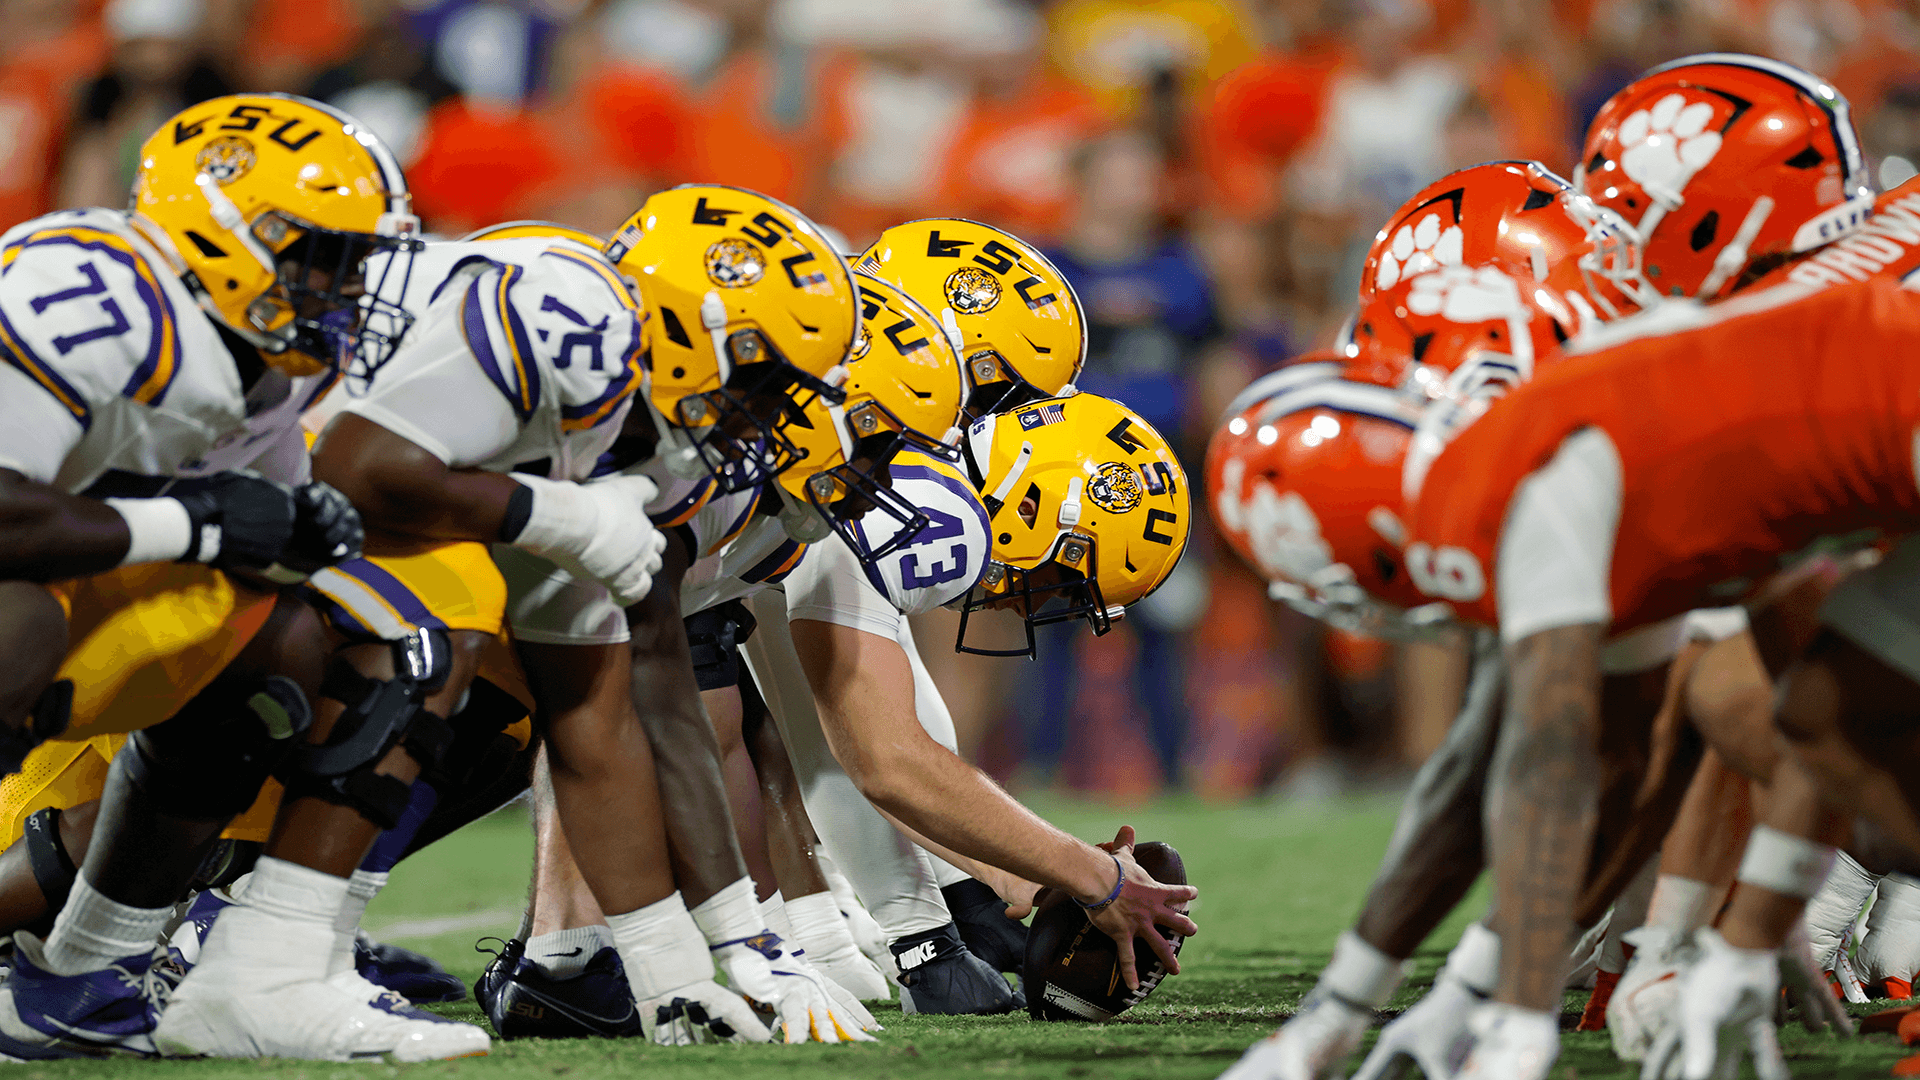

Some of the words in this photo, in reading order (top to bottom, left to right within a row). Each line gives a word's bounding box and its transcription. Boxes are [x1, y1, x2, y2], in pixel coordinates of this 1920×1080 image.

[174, 105, 323, 152] LSU
[692, 197, 827, 288] LSU
[926, 230, 1058, 311] LSU
[29, 261, 132, 357] 77
[857, 285, 930, 356] SU
[1105, 417, 1177, 546] LSU
[892, 506, 968, 590] 43
[898, 940, 937, 970] NIKE
